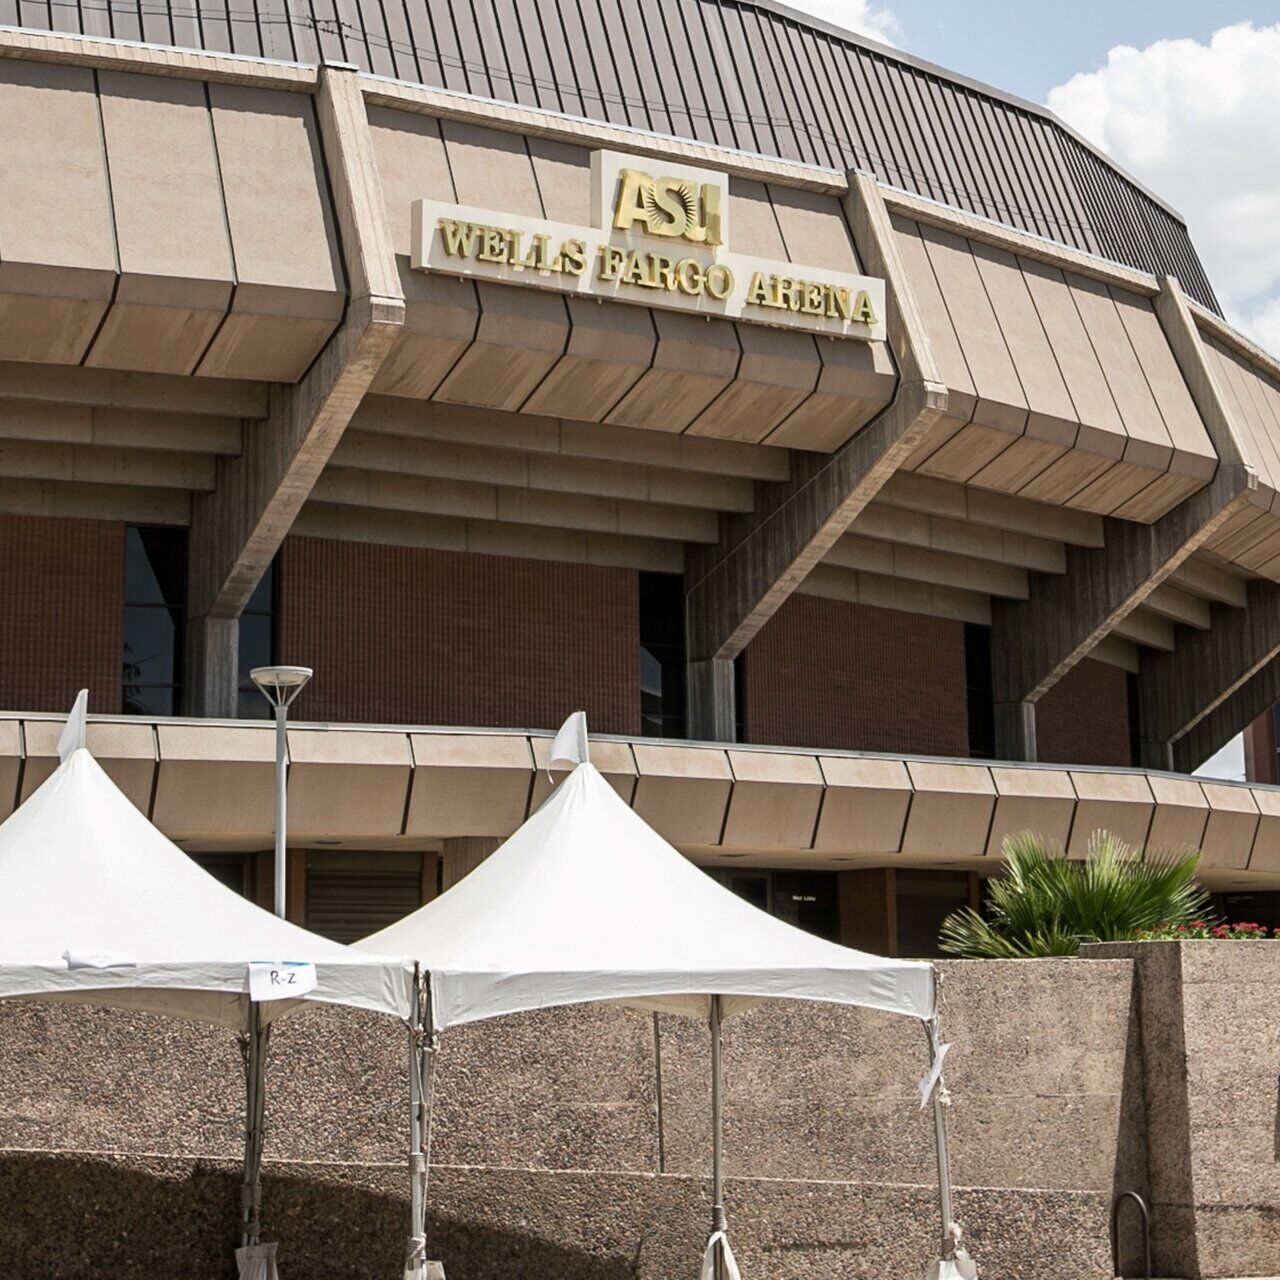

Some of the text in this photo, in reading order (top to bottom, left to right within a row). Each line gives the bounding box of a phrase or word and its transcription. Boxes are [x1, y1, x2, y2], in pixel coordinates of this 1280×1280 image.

[613, 168, 724, 246] ASU
[437, 217, 880, 325] WELLS FARGO ARENA
[270, 970, 297, 985] R-Z
